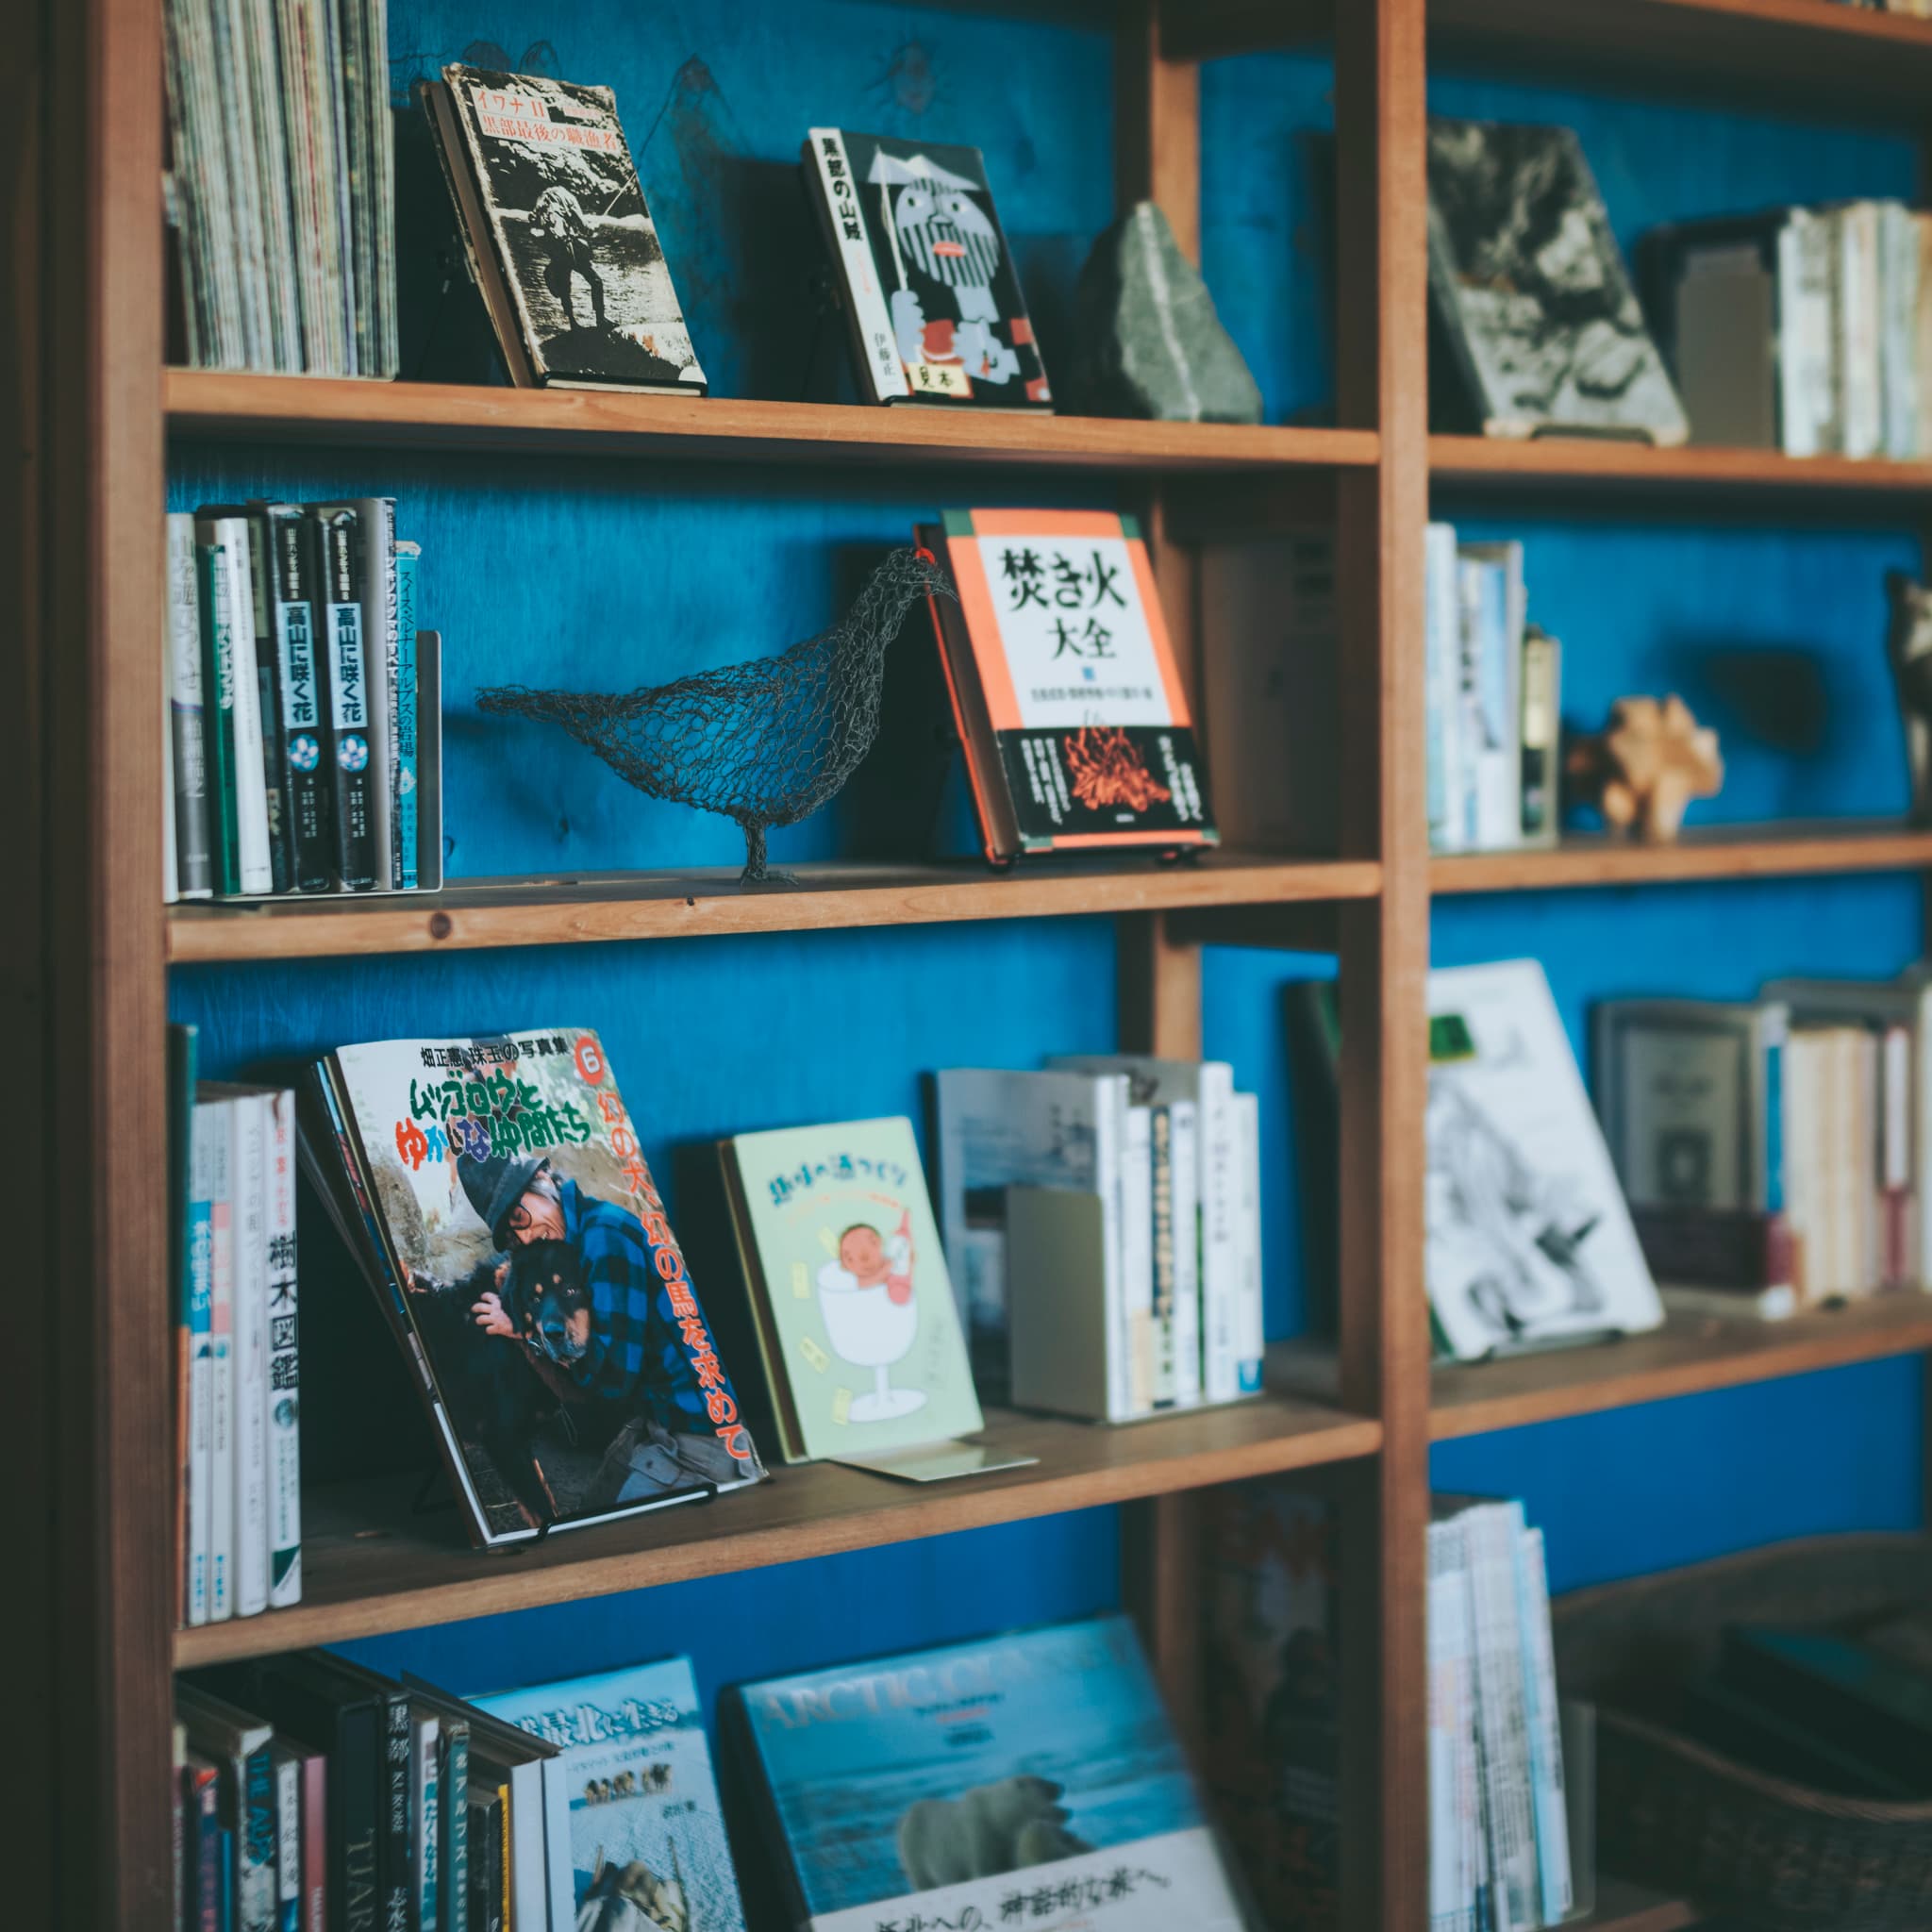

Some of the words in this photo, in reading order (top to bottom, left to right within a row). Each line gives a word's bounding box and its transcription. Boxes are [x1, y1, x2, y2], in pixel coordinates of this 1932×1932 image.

[998, 547, 1127, 611] 焚き火
[286, 605, 314, 724] 高山に咲く花
[336, 606, 362, 724] 高山に咲く花
[1047, 617, 1117, 660] 大全
[421, 1046, 464, 1068] 畑正憲
[470, 1036, 570, 1067] 珠玉の写真集
[581, 1045, 600, 1074] 6
[409, 1067, 543, 1123] ムツゴロウと
[395, 1100, 591, 1172] ゆかいな仲間たち
[269, 1230, 299, 1391] 樹木図鑑
[761, 1664, 937, 1733] ARCTIC
